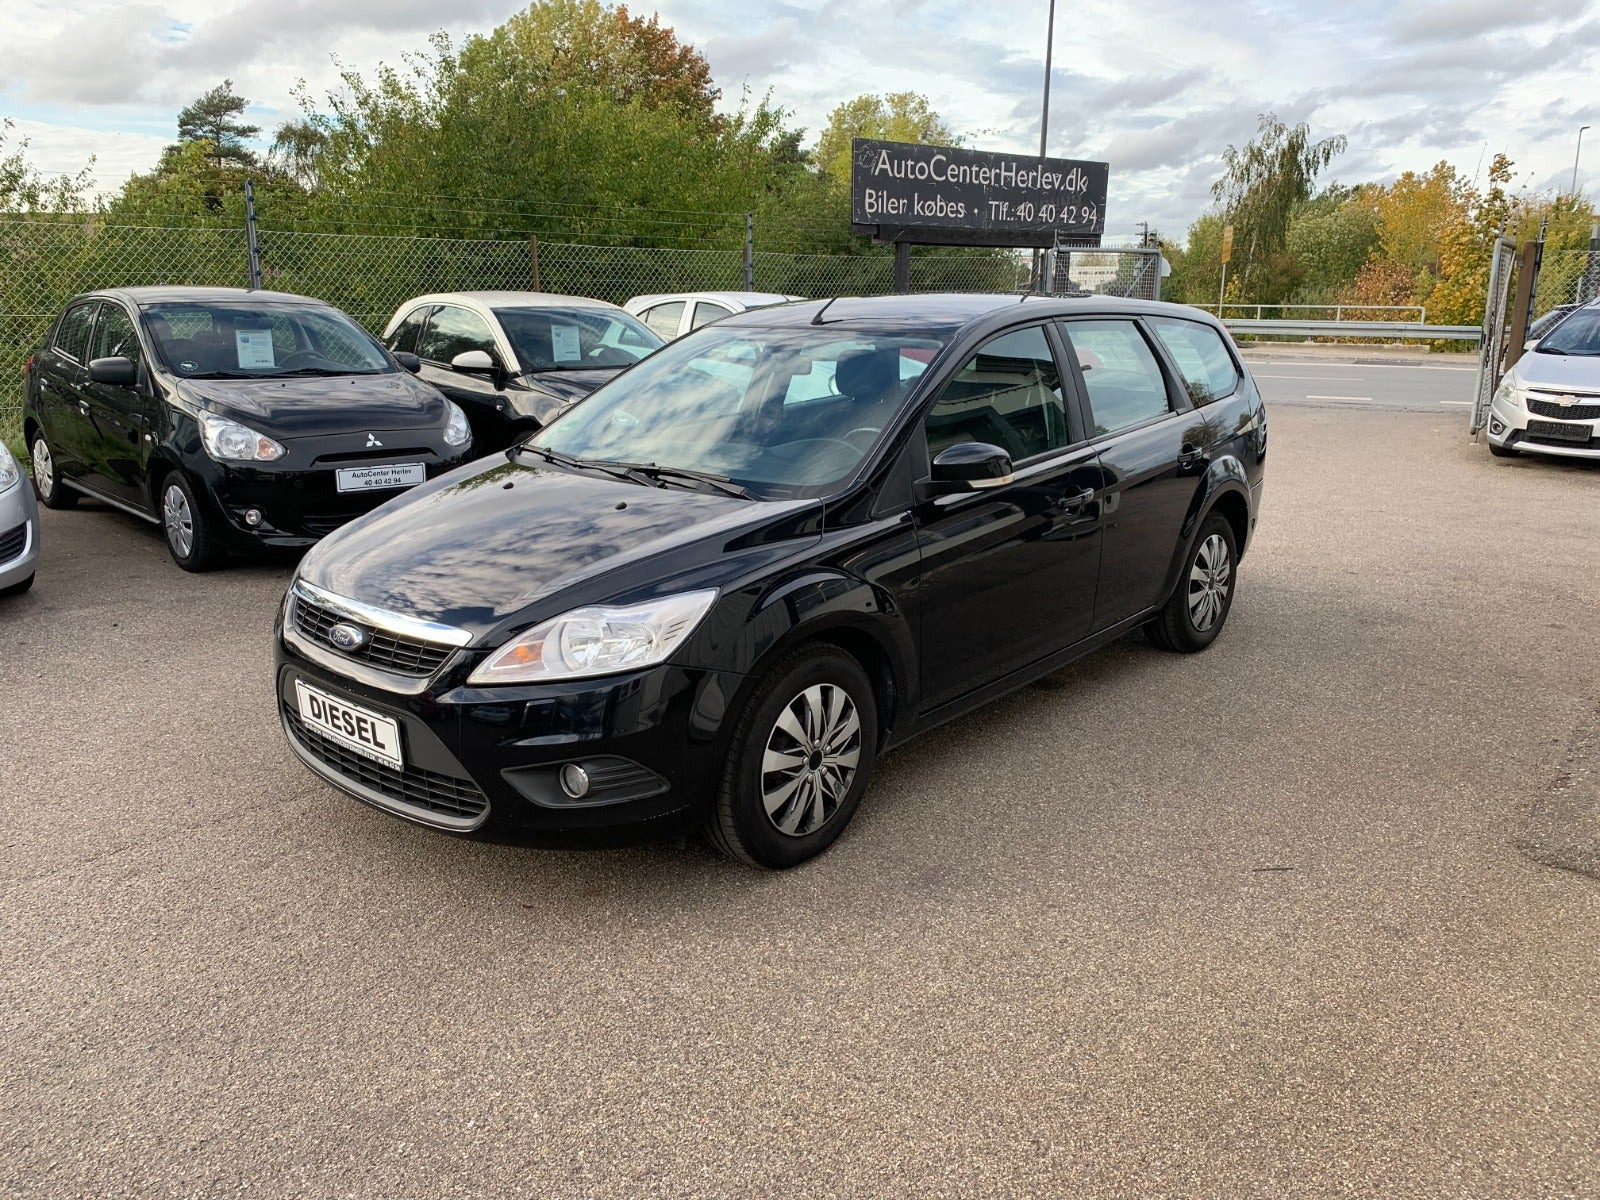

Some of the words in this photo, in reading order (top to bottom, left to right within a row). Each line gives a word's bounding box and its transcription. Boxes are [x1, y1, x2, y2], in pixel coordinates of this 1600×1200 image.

[874, 149, 1088, 193] AutoCenterHerlev.dk
[865, 188, 907, 215] Biler
[914, 192, 966, 218] købes
[1038, 204, 1056, 223] 40
[1059, 206, 1076, 224] 42
[1081, 206, 1098, 224] 94
[352, 470, 390, 479] AutoCenter
[383, 477, 392, 485] 42
[333, 630, 351, 645] Ford
[308, 693, 386, 751] DIESEL
